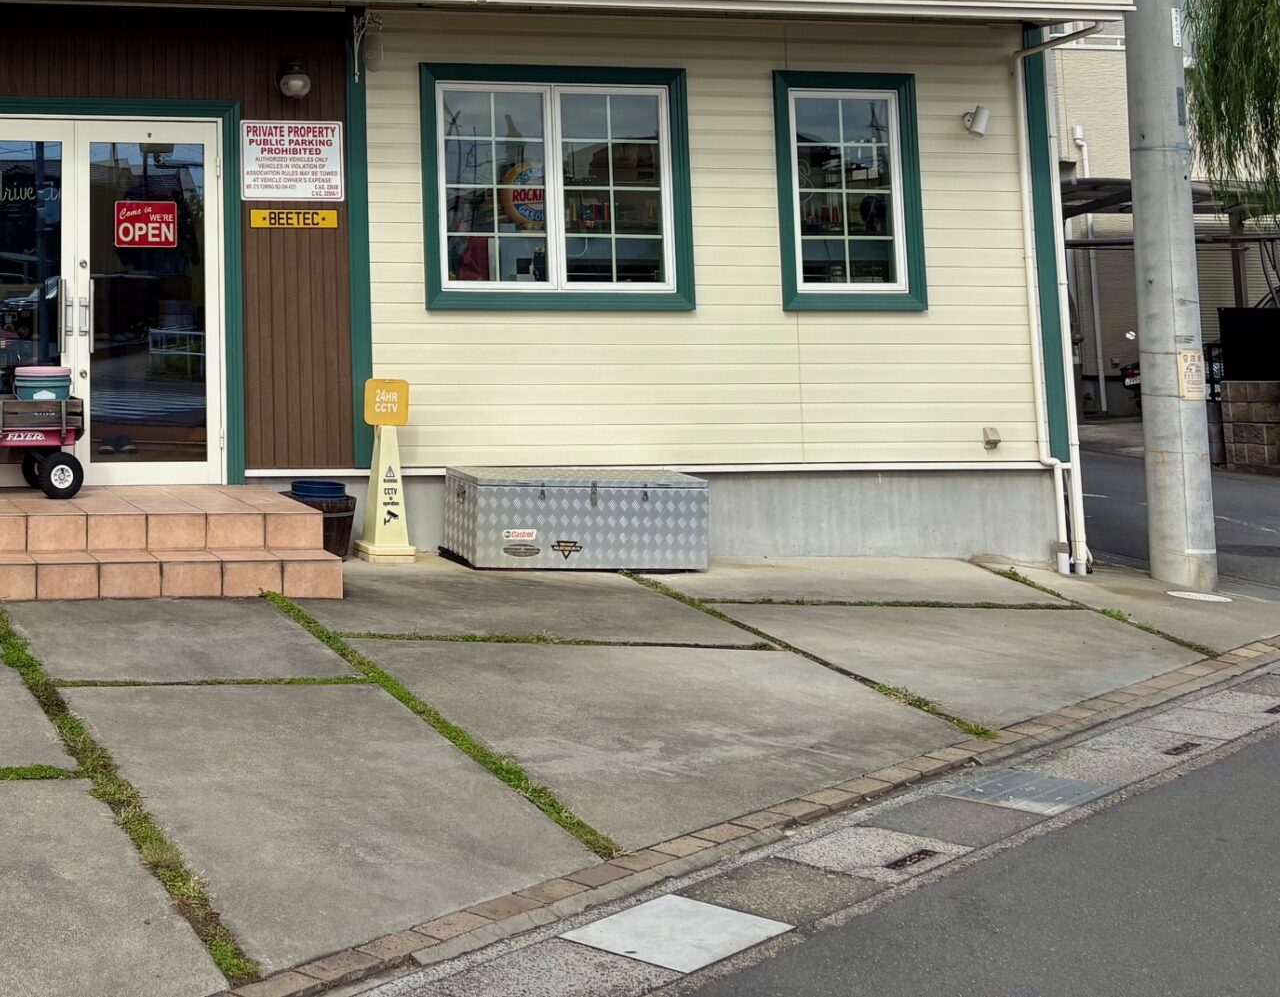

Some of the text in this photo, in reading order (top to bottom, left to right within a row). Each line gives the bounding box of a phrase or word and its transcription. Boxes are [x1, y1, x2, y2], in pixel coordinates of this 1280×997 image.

[246, 125, 336, 139] PRIVATE PROPERTY
[248, 138, 333, 147] PUBLIC PARKING
[260, 147, 322, 156] PROHIBITED
[119, 205, 152, 220] Come in
[150, 213, 174, 222] WE'RE
[269, 211, 320, 226] BEETEC
[118, 222, 174, 243] OPEN
[375, 388, 398, 402] 24HR
[374, 403, 398, 413] CCTV
[6, 431, 45, 441] FLYER
[384, 488, 398, 496] CCTV
